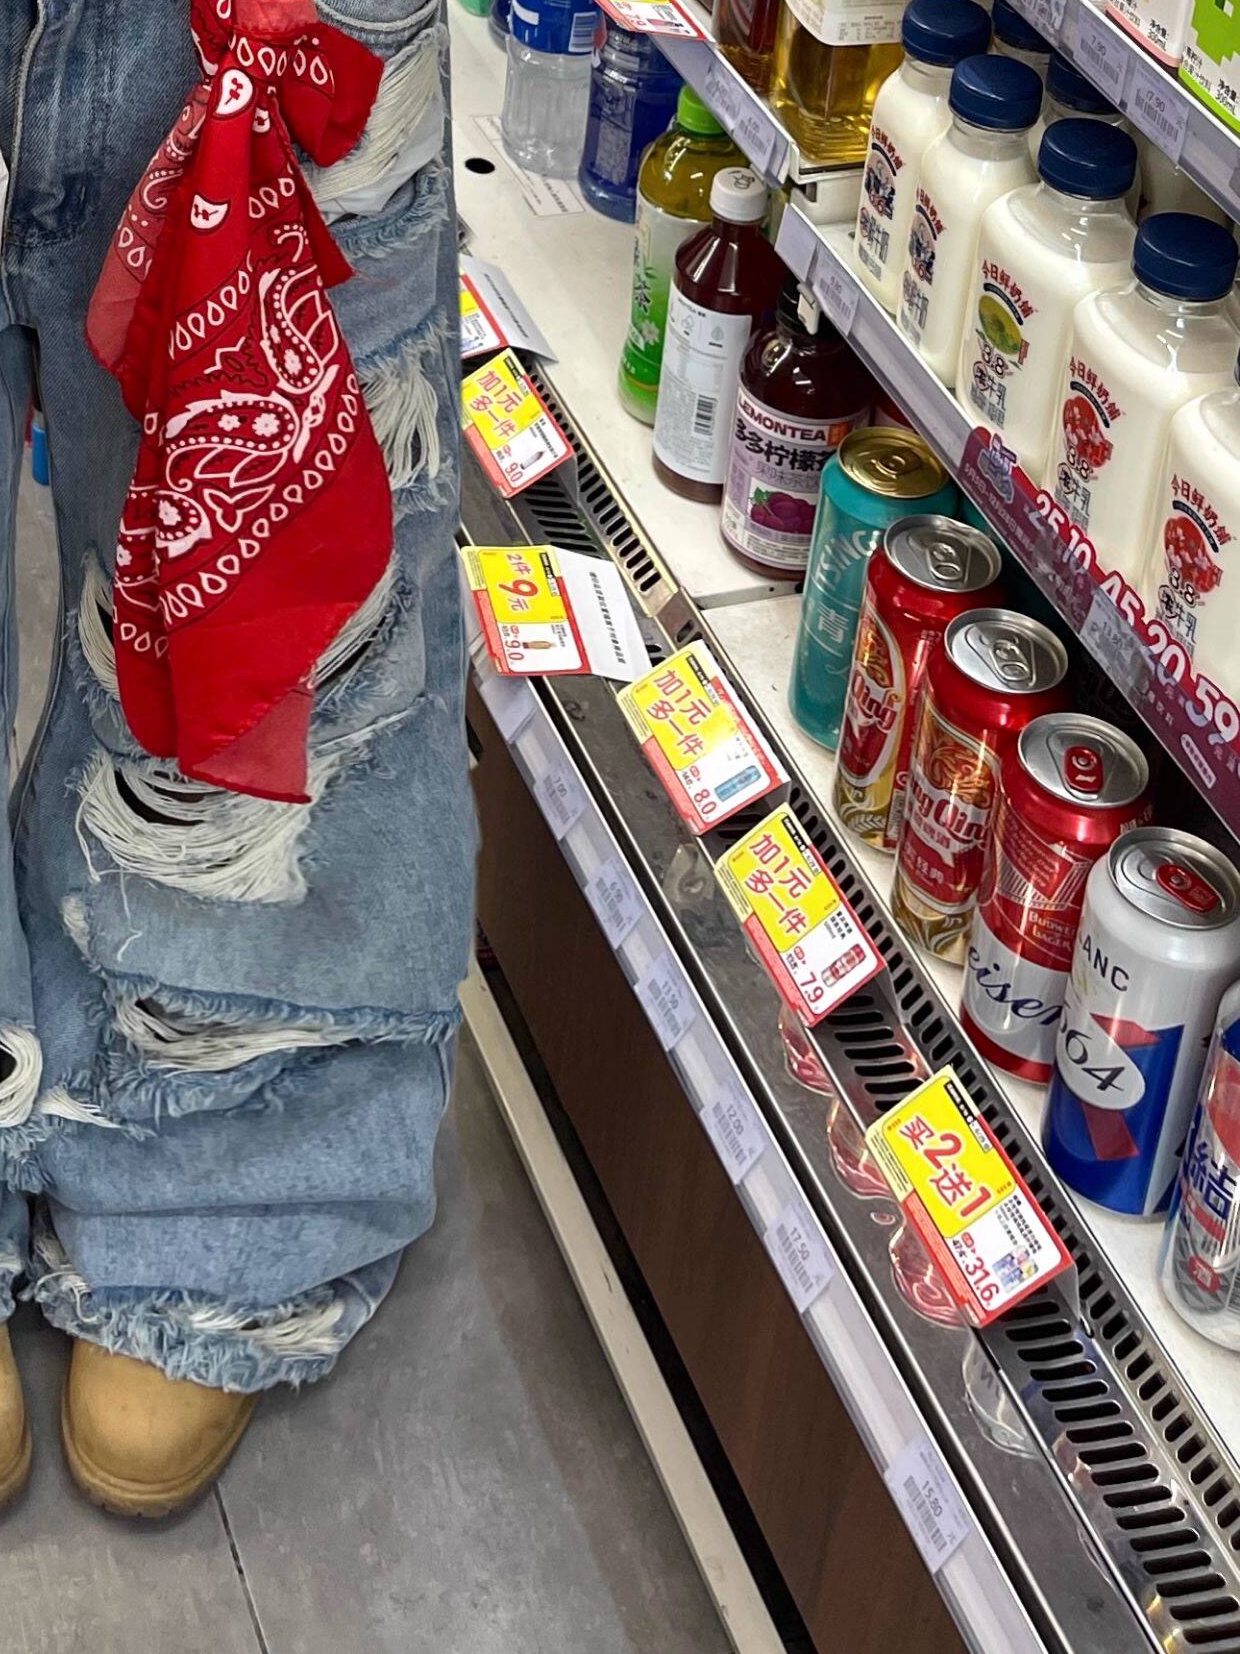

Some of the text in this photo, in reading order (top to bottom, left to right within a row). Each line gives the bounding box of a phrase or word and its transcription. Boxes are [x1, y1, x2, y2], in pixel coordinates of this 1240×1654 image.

[981, 258, 1035, 320] 今日鲜奶铺
[1068, 355, 1123, 423] 今日鲜奶铺
[738, 395, 828, 443] LEMONTEA
[1170, 472, 1232, 546] 今日鲜奶铺
[653, 669, 713, 726] 加1元
[645, 699, 705, 756] 多一件
[693, 787, 718, 816] 8.0
[749, 833, 813, 900] 加1元
[744, 868, 808, 935] 多一件
[799, 970, 825, 1004] 7.9
[898, 1114, 994, 1219] 买2送1
[964, 1255, 1000, 1304] 31.6
[921, 1479, 943, 1517] 15.80
